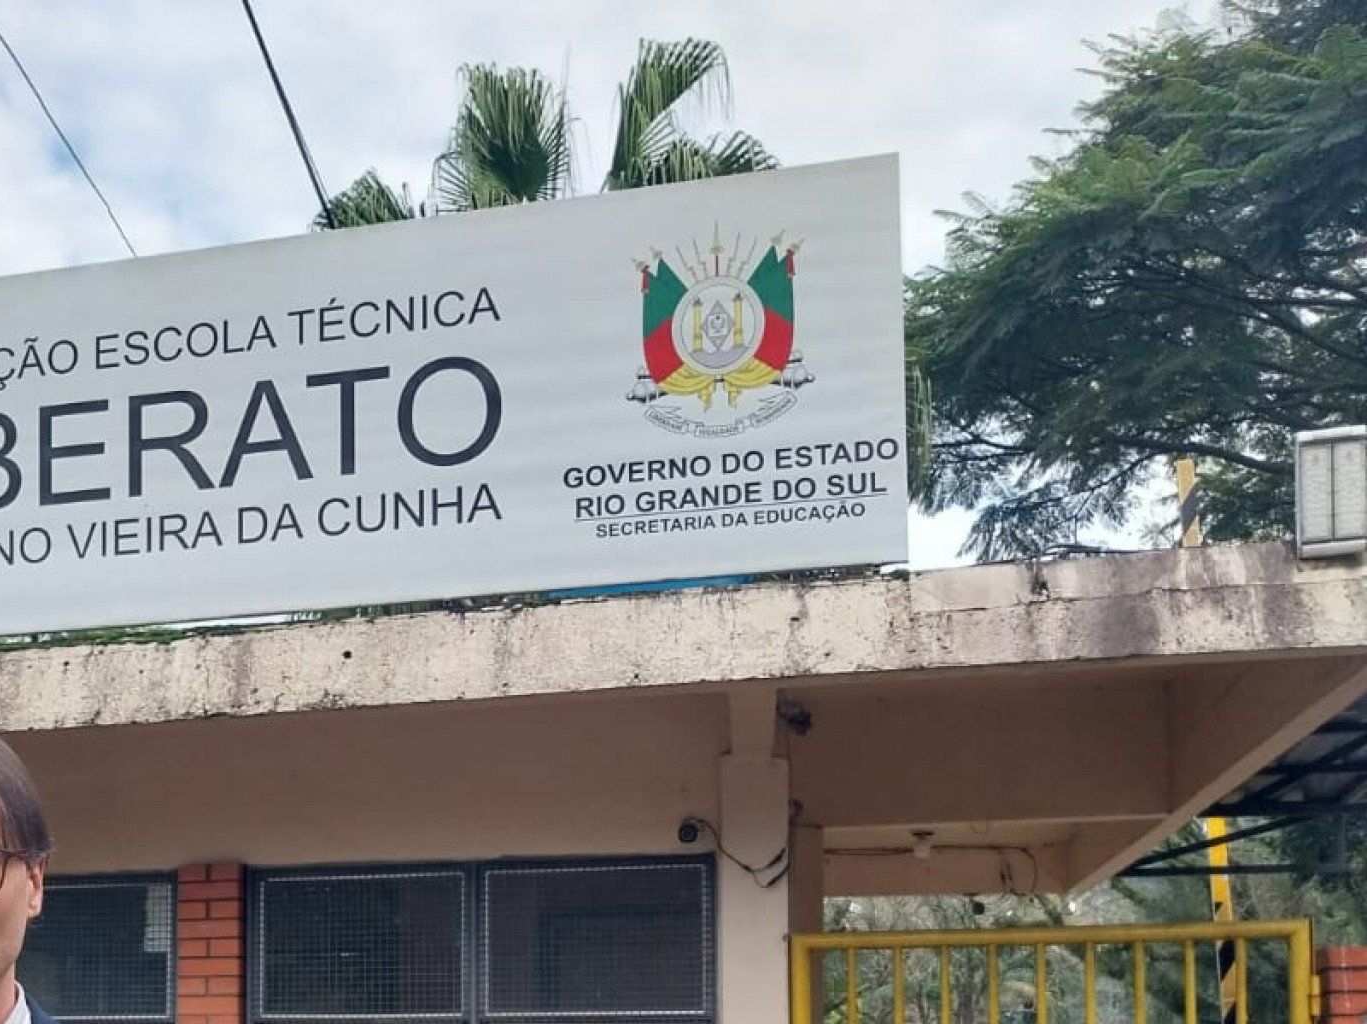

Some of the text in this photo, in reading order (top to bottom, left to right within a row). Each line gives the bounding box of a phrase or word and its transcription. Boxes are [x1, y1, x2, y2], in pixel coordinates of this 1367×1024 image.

[95, 315, 278, 369] ESCOLA
[286, 286, 502, 346] TÉCNICA
[563, 438, 899, 489] GOVERNO DO ESTADO
[66, 510, 224, 559] VIEIRA
[237, 502, 304, 544] DA
[317, 482, 503, 537] CUNHA
[575, 471, 888, 519] RIO GRANDE DO SUL
[595, 500, 866, 539] SECRETARIA DA EDUCAÇÃO
